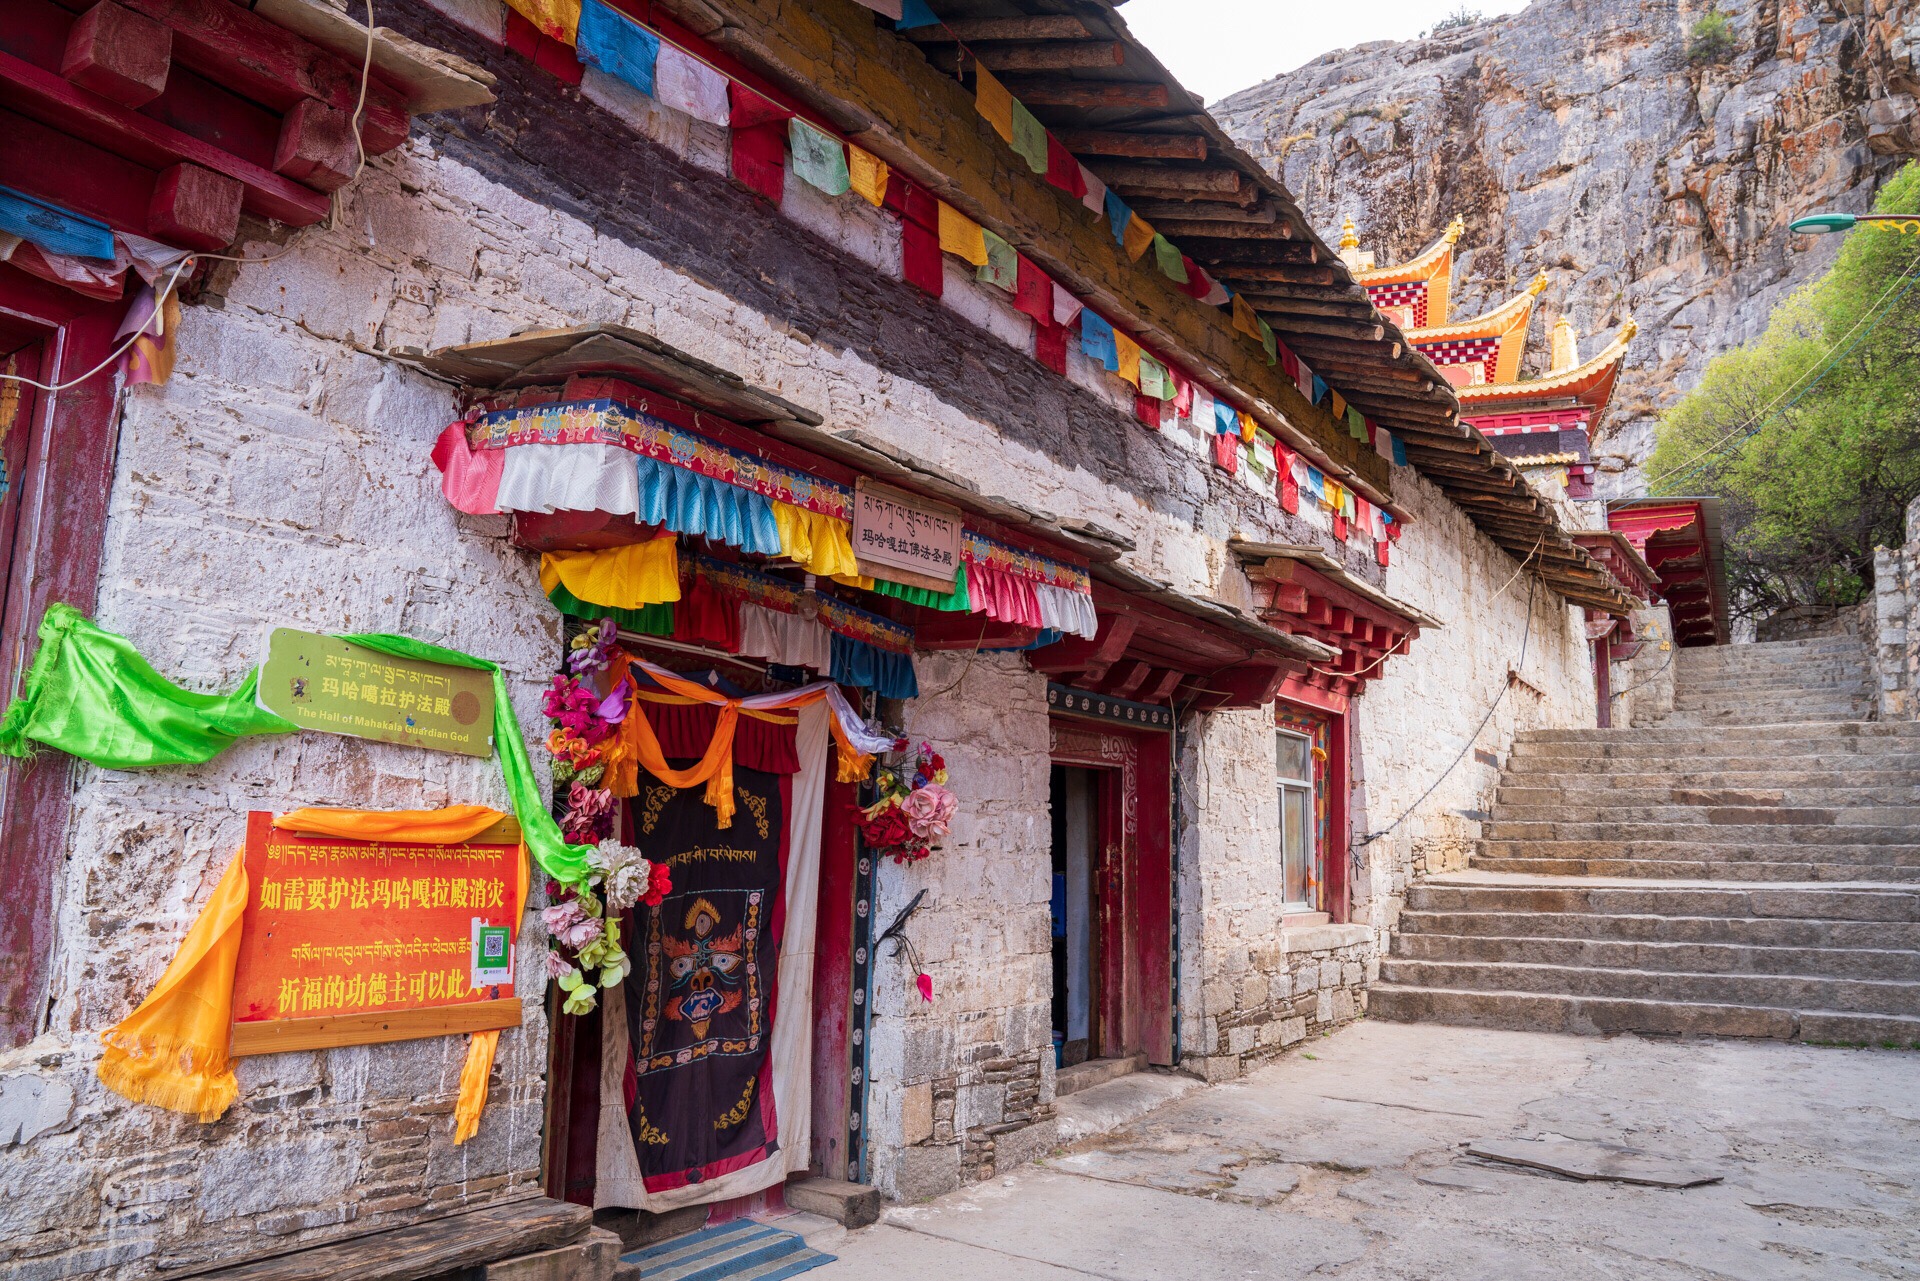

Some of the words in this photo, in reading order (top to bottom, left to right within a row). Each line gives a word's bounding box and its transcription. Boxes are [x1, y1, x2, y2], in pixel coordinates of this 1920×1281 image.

[862, 528, 953, 567] 玛哈嘎拉佛法圣殿
[321, 676, 451, 717] 玛哈噶拉护法殿
[297, 706, 317, 719] The
[319, 710, 340, 722] Hall
[342, 714, 353, 724] of
[355, 716, 403, 732] Mahakala
[405, 725, 448, 740] Guardian
[450, 731, 469, 743] God
[259, 876, 505, 911] 如需要护法玛哈嘎拉殿消灾
[277, 968, 483, 1014] 祈福的功德主可以此
